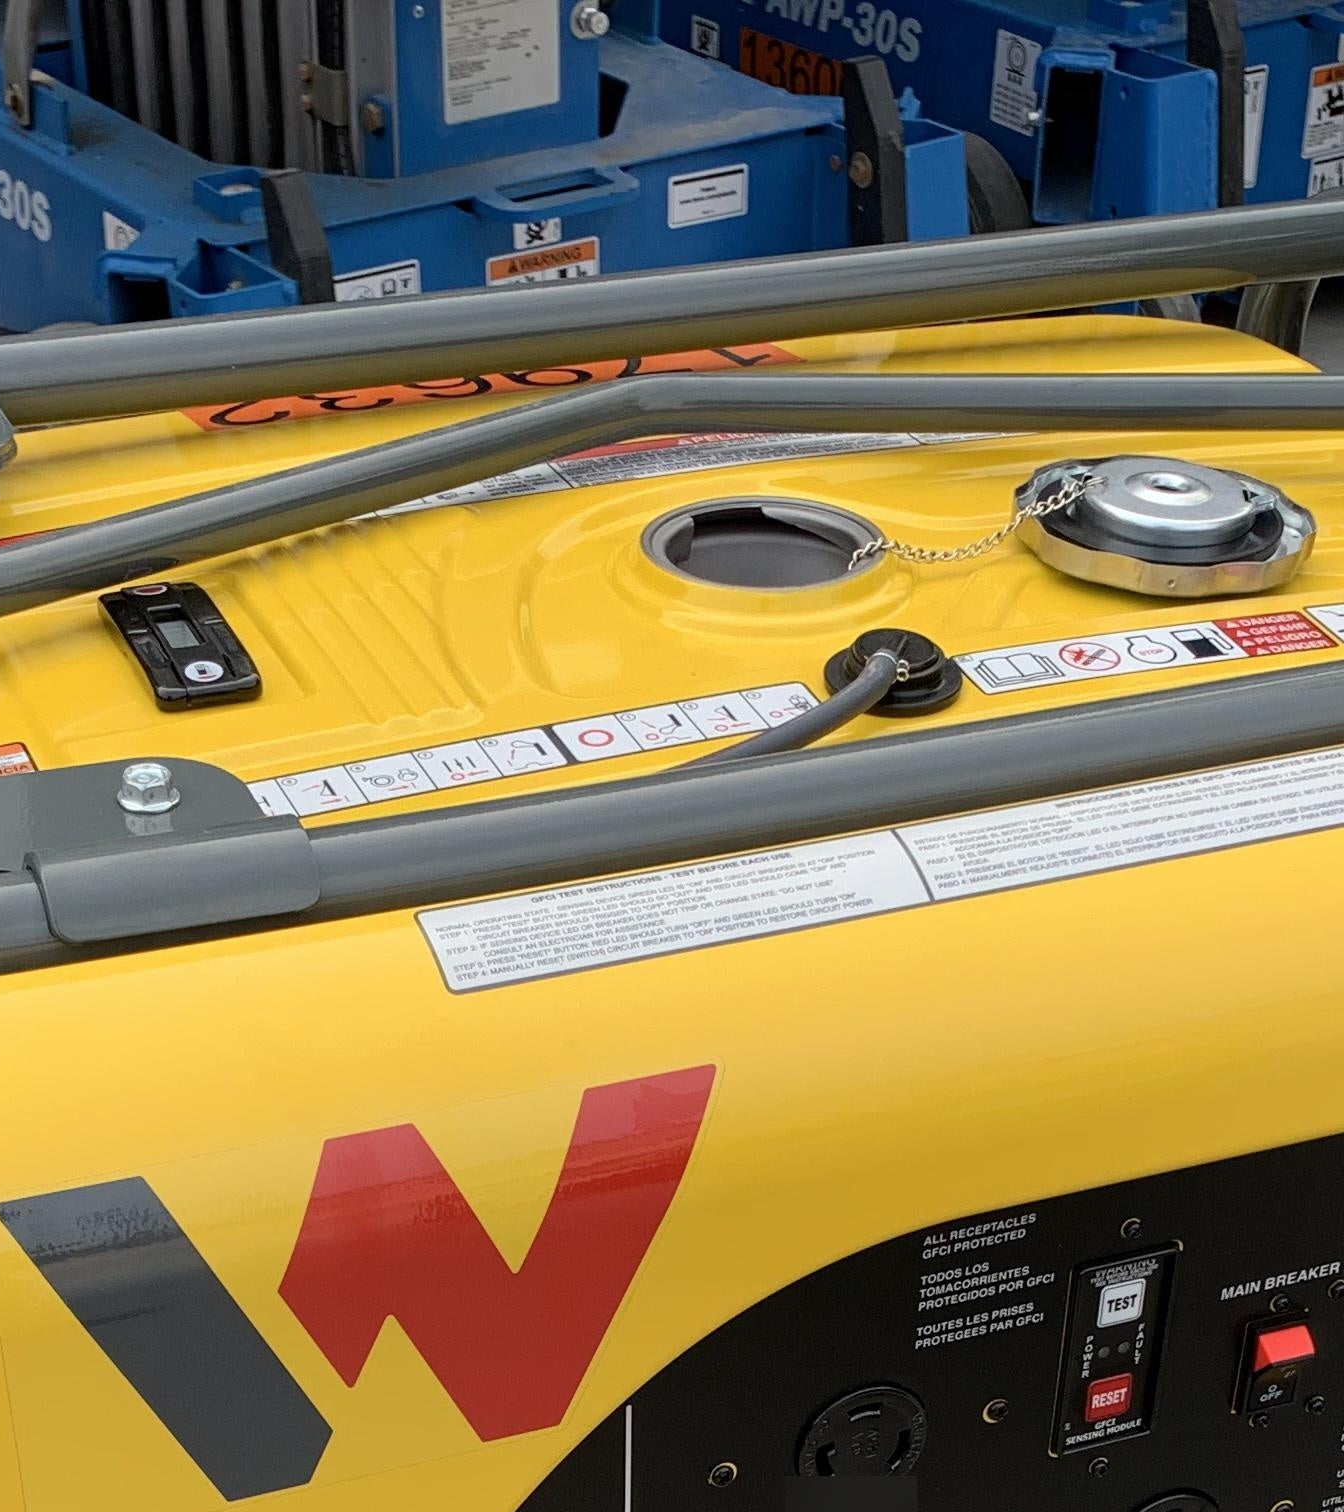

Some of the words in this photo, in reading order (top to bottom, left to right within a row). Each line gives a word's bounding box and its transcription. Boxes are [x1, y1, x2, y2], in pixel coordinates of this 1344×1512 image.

[1238, 613, 1299, 627] DANGER
[1249, 622, 1310, 635] GEFAHR
[1253, 630, 1322, 644] PELIGRO
[1268, 639, 1330, 653] DANGER
[921, 1244, 951, 1260] GFCI
[953, 1228, 1026, 1252] PROTECTED
[922, 1232, 947, 1247] ALL
[949, 1212, 1036, 1240] RECEPTACLES
[919, 1265, 1030, 1298] TOMACORRIENTES
[920, 1267, 962, 1285] TODOS
[964, 1261, 990, 1276] LOS
[1220, 1279, 1261, 1301] MAIN
[1264, 1261, 1341, 1290] BREAKER
[917, 1285, 996, 1311] PROTEGIDOS
[998, 1279, 1024, 1294] POR
[1026, 1272, 1055, 1287] GFCI
[1106, 1294, 1138, 1313] TEST
[914, 1324, 987, 1349] PROTEGEES
[989, 1318, 1014, 1333] PAR
[1015, 1312, 1044, 1327] GFCI
[916, 1317, 964, 1337] TOUTES
[965, 1311, 989, 1326] LES
[991, 1301, 1034, 1320] PRISES
[1081, 1335, 1094, 1379] POWER
[1134, 1323, 1146, 1365] FAULT
[1091, 1387, 1128, 1409] RESET
[1259, 1390, 1284, 1402] OFF
[1065, 1428, 1105, 1446] SENSING
[1105, 1417, 1142, 1435] MODULE
[1094, 1417, 1116, 1430] GFCI
